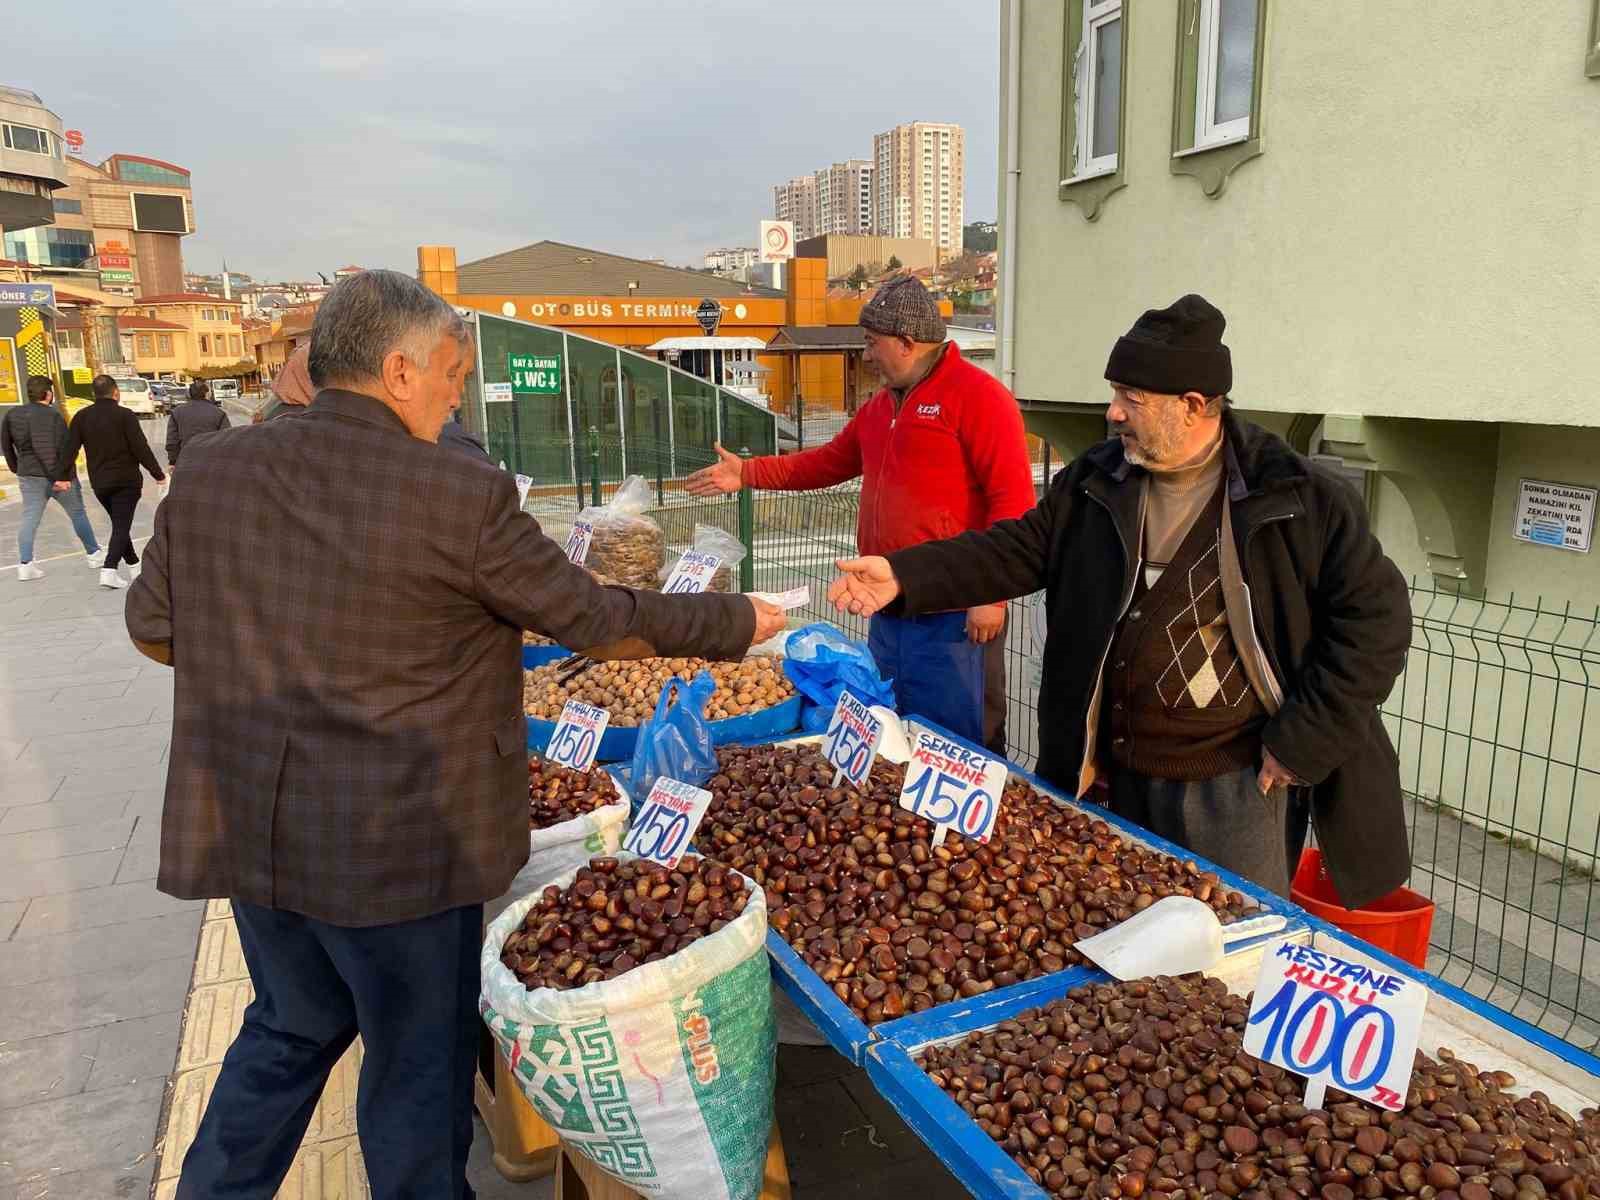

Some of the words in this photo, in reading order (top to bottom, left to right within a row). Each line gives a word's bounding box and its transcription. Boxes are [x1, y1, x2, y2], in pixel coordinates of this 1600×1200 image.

[512, 358, 527, 368] BAY
[534, 359, 557, 369] BAYAN
[524, 371, 547, 388] WC
[1523, 484, 1550, 495] SONRA
[1552, 488, 1591, 502] OLMADAN
[1565, 514, 1581, 523] VER
[551, 723, 595, 768] 150
[827, 720, 871, 782] 150
[912, 748, 988, 785] KESTANE
[649, 789, 695, 812] KESTANE
[903, 766, 993, 838] 150
[628, 803, 690, 860] 150
[1276, 942, 1406, 996] KESTANE
[1284, 963, 1377, 1006] KUZU
[1249, 979, 1395, 1091] 100
[1371, 1085, 1404, 1110] TL
